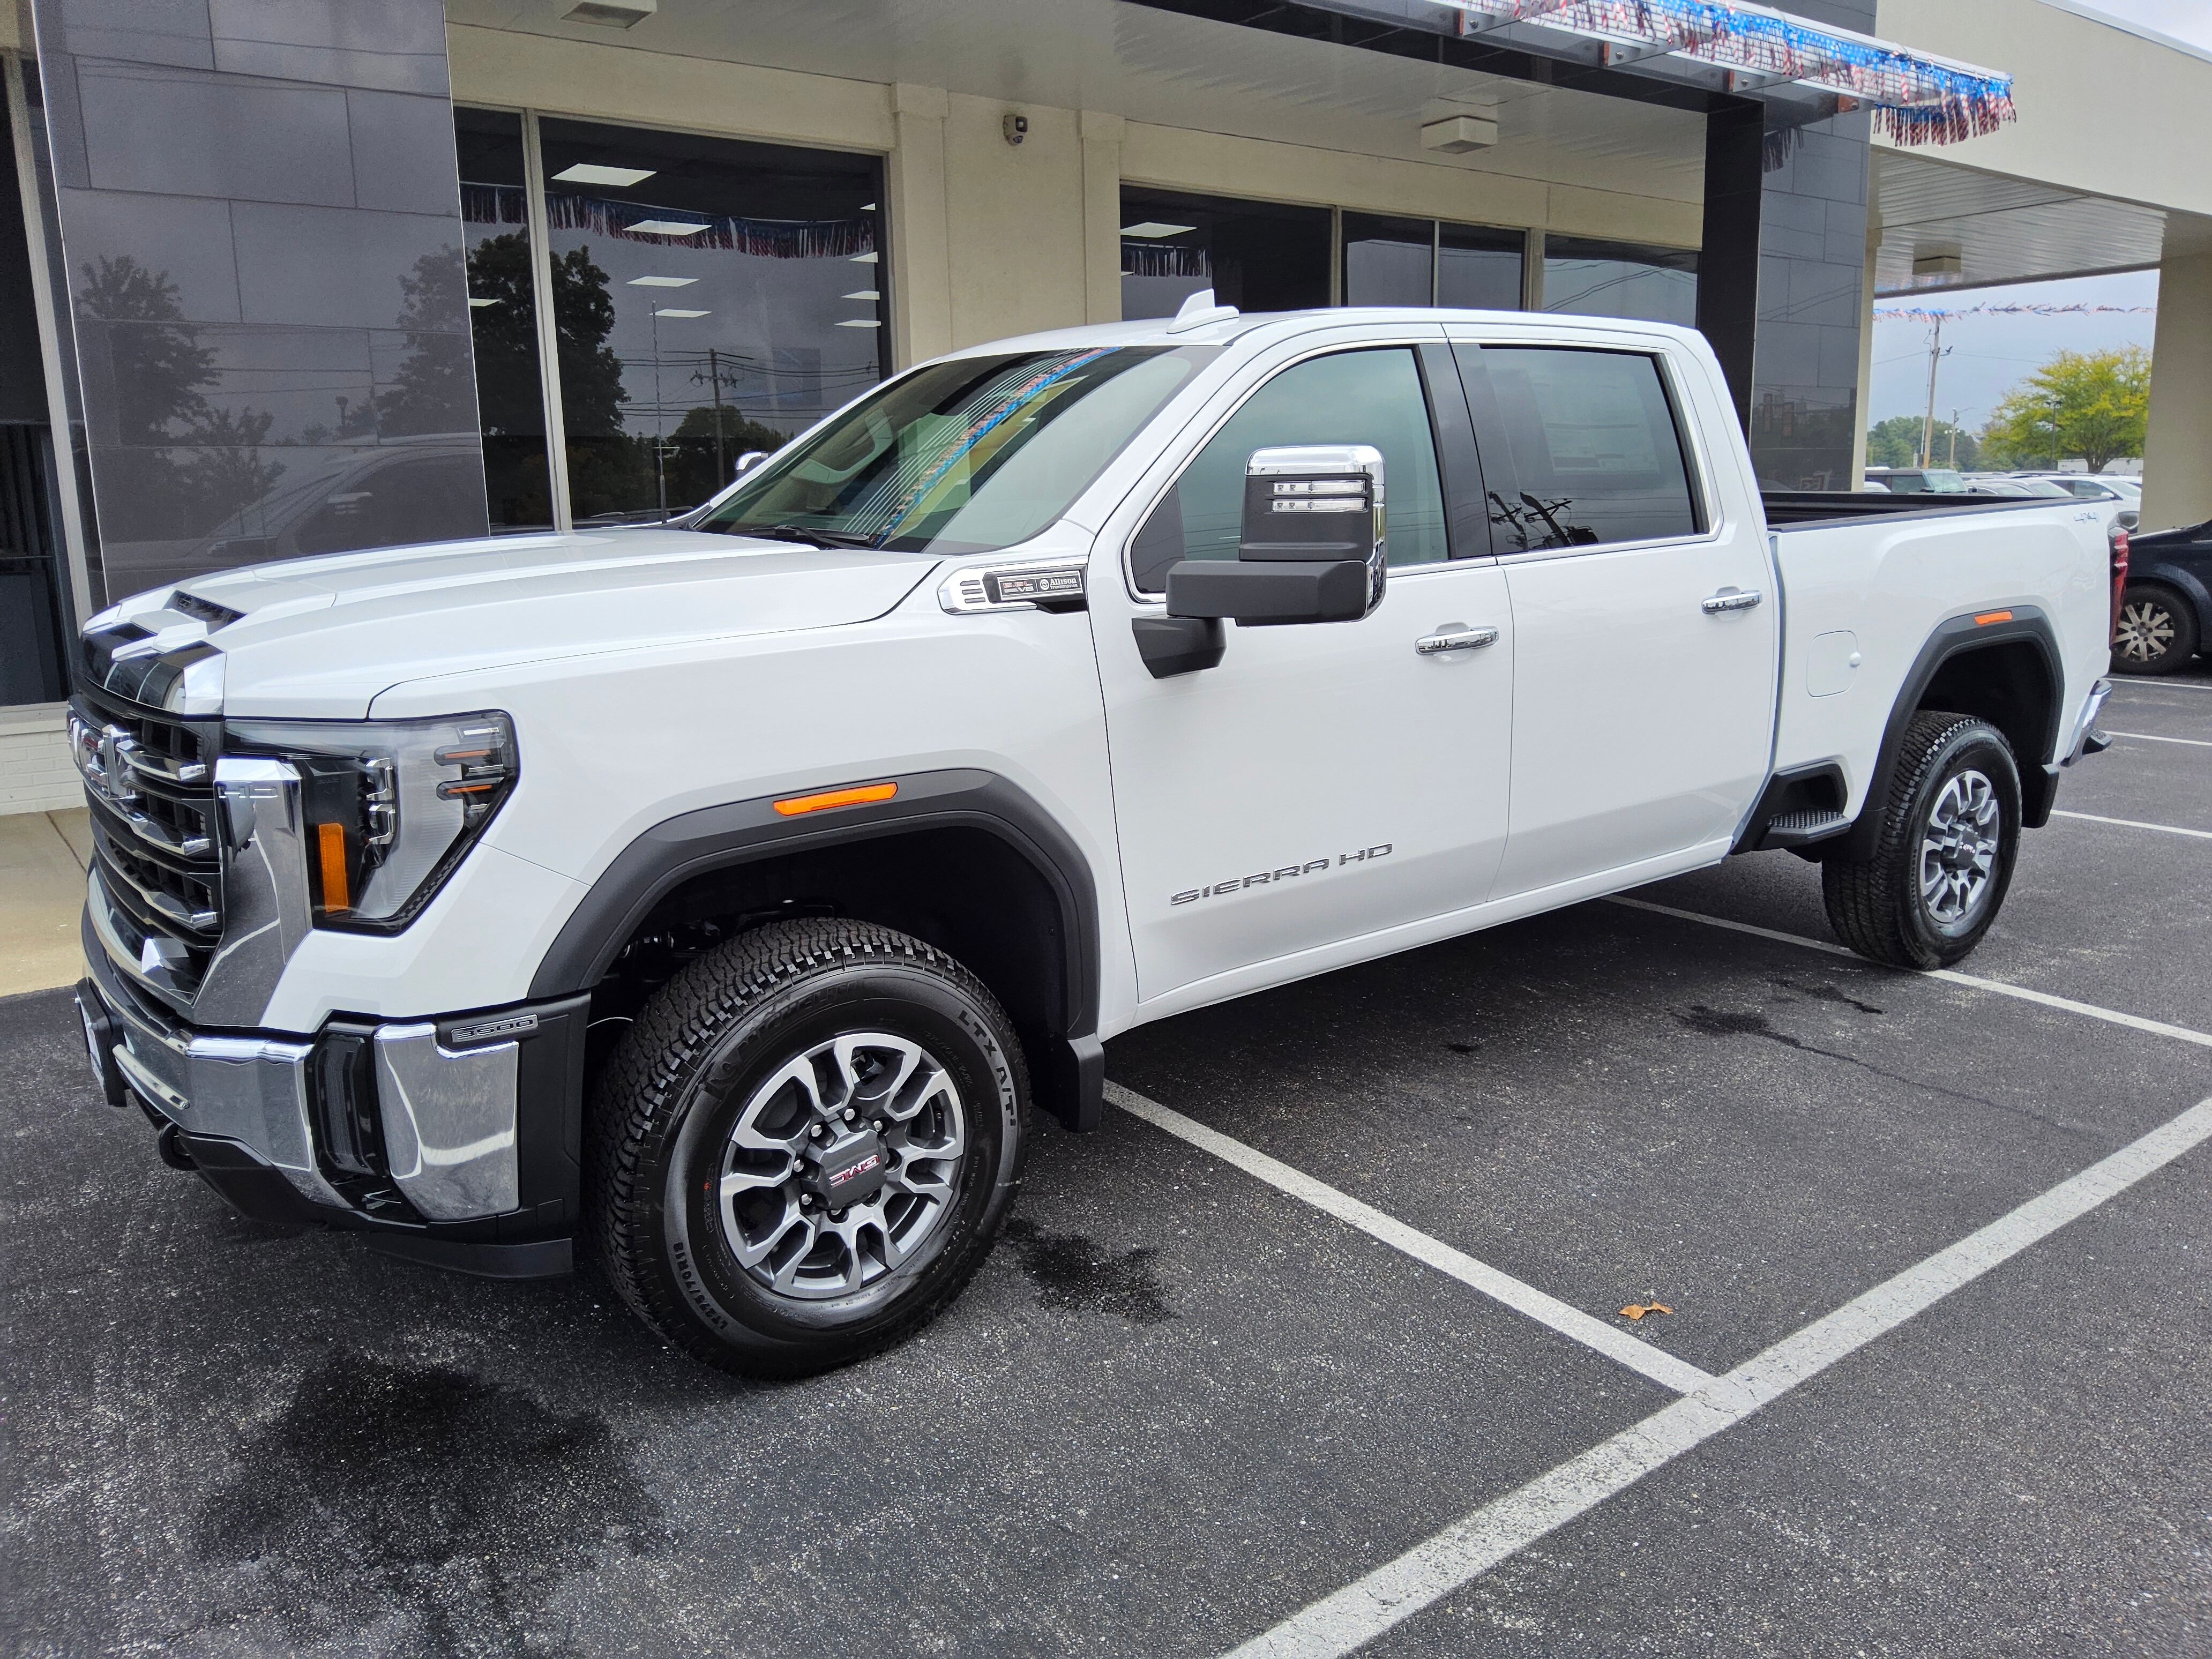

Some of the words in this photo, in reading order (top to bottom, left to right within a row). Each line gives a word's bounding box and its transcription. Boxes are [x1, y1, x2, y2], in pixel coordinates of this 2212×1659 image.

[1050, 578, 1077, 586] Allison
[1170, 857, 1329, 906] SIERRA
[1339, 842, 1393, 866] HD
[457, 1019, 534, 1040] 3500
[958, 1010, 997, 1057] LTX
[828, 1154, 880, 1189] GMC
[673, 1242, 728, 1329] LT275/70R18
